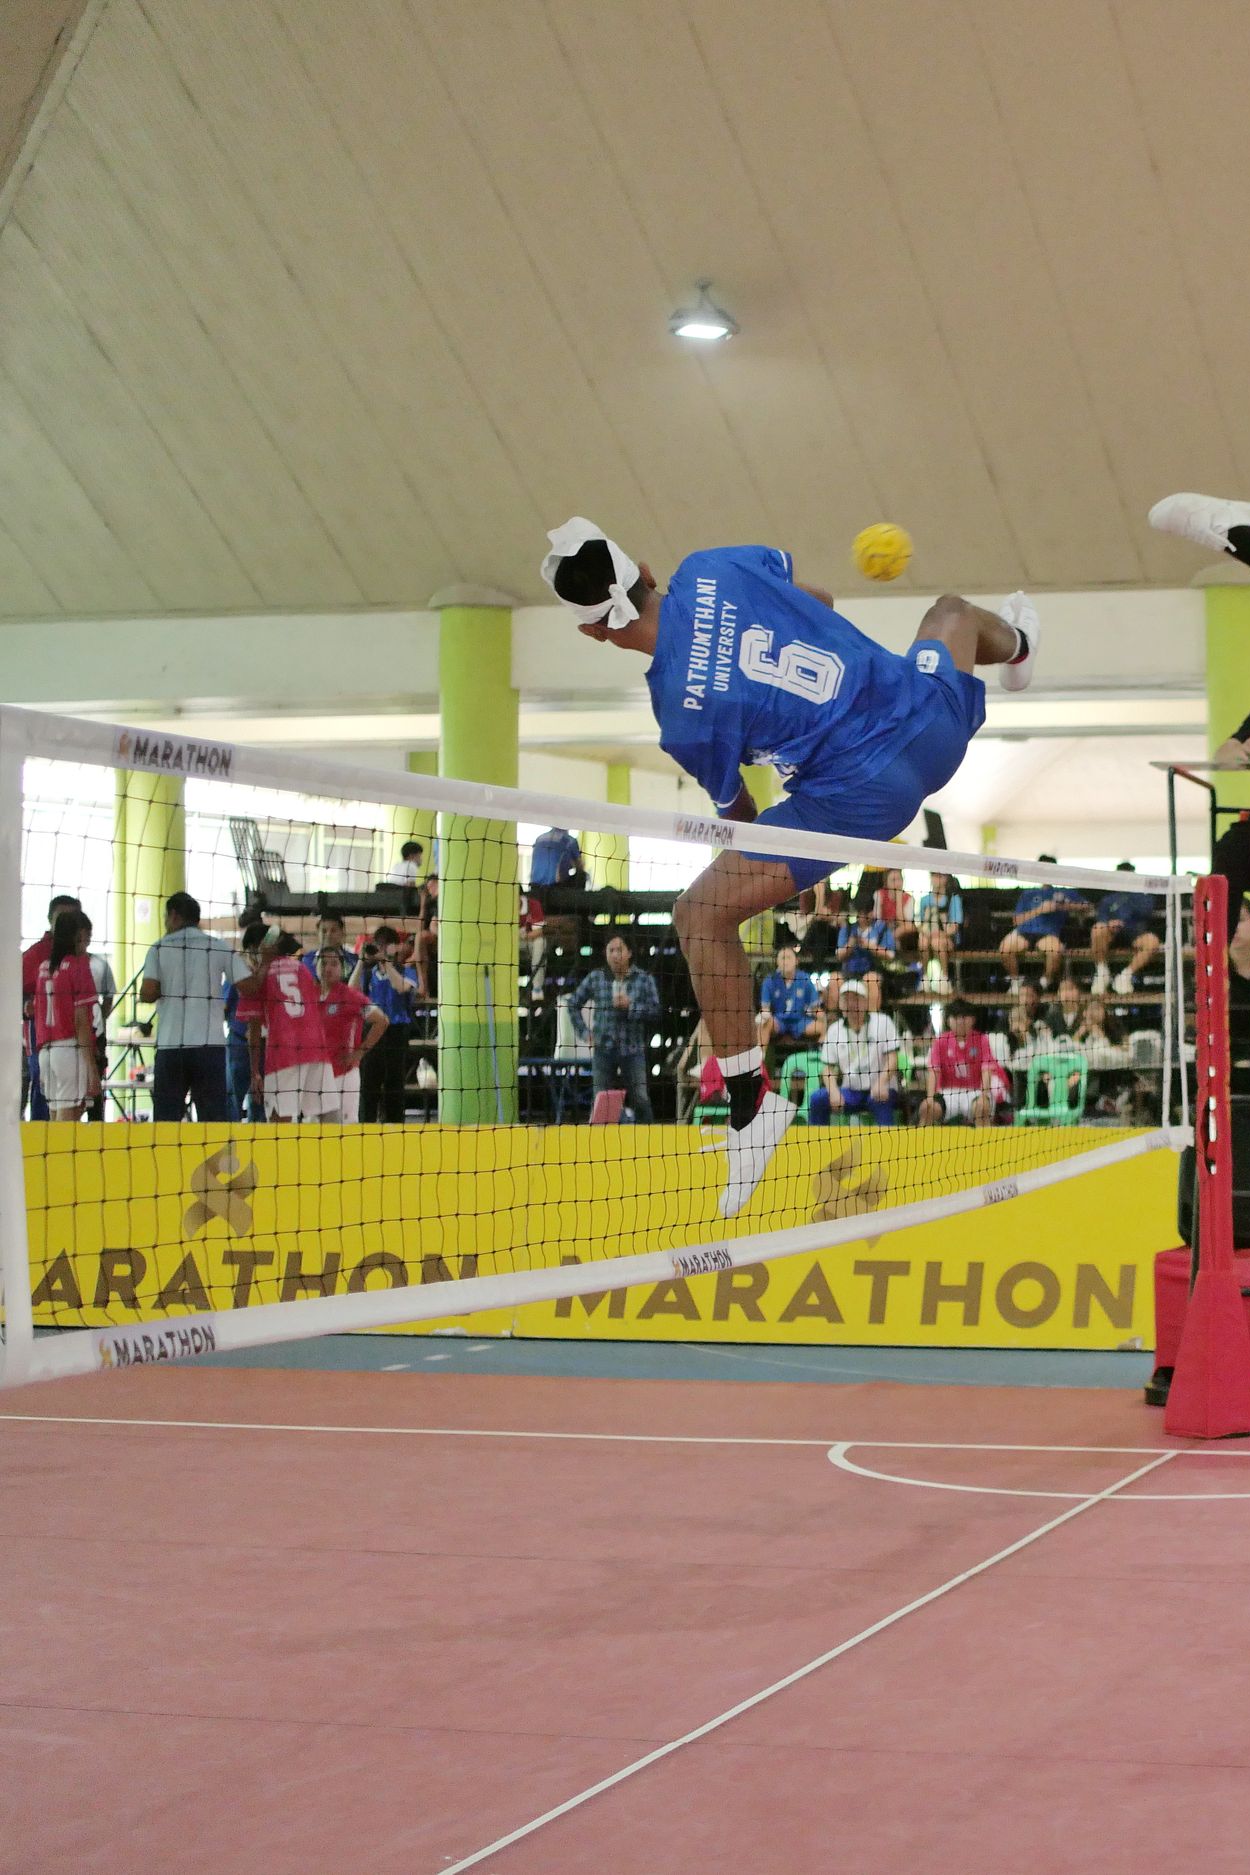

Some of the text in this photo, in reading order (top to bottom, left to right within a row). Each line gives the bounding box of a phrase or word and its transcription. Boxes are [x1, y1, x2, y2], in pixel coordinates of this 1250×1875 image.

[683, 577, 717, 710] PATHUMTHANI
[713, 601, 738, 692] UNIVERSITY
[738, 624, 845, 705] 6
[133, 735, 232, 777] MARATHON
[683, 820, 735, 846] MARATHON
[276, 973, 306, 1019] 5
[679, 1248, 733, 1276] MARATHON
[554, 1255, 1137, 1330] MARATHON
[113, 1325, 216, 1367] MARATHON
